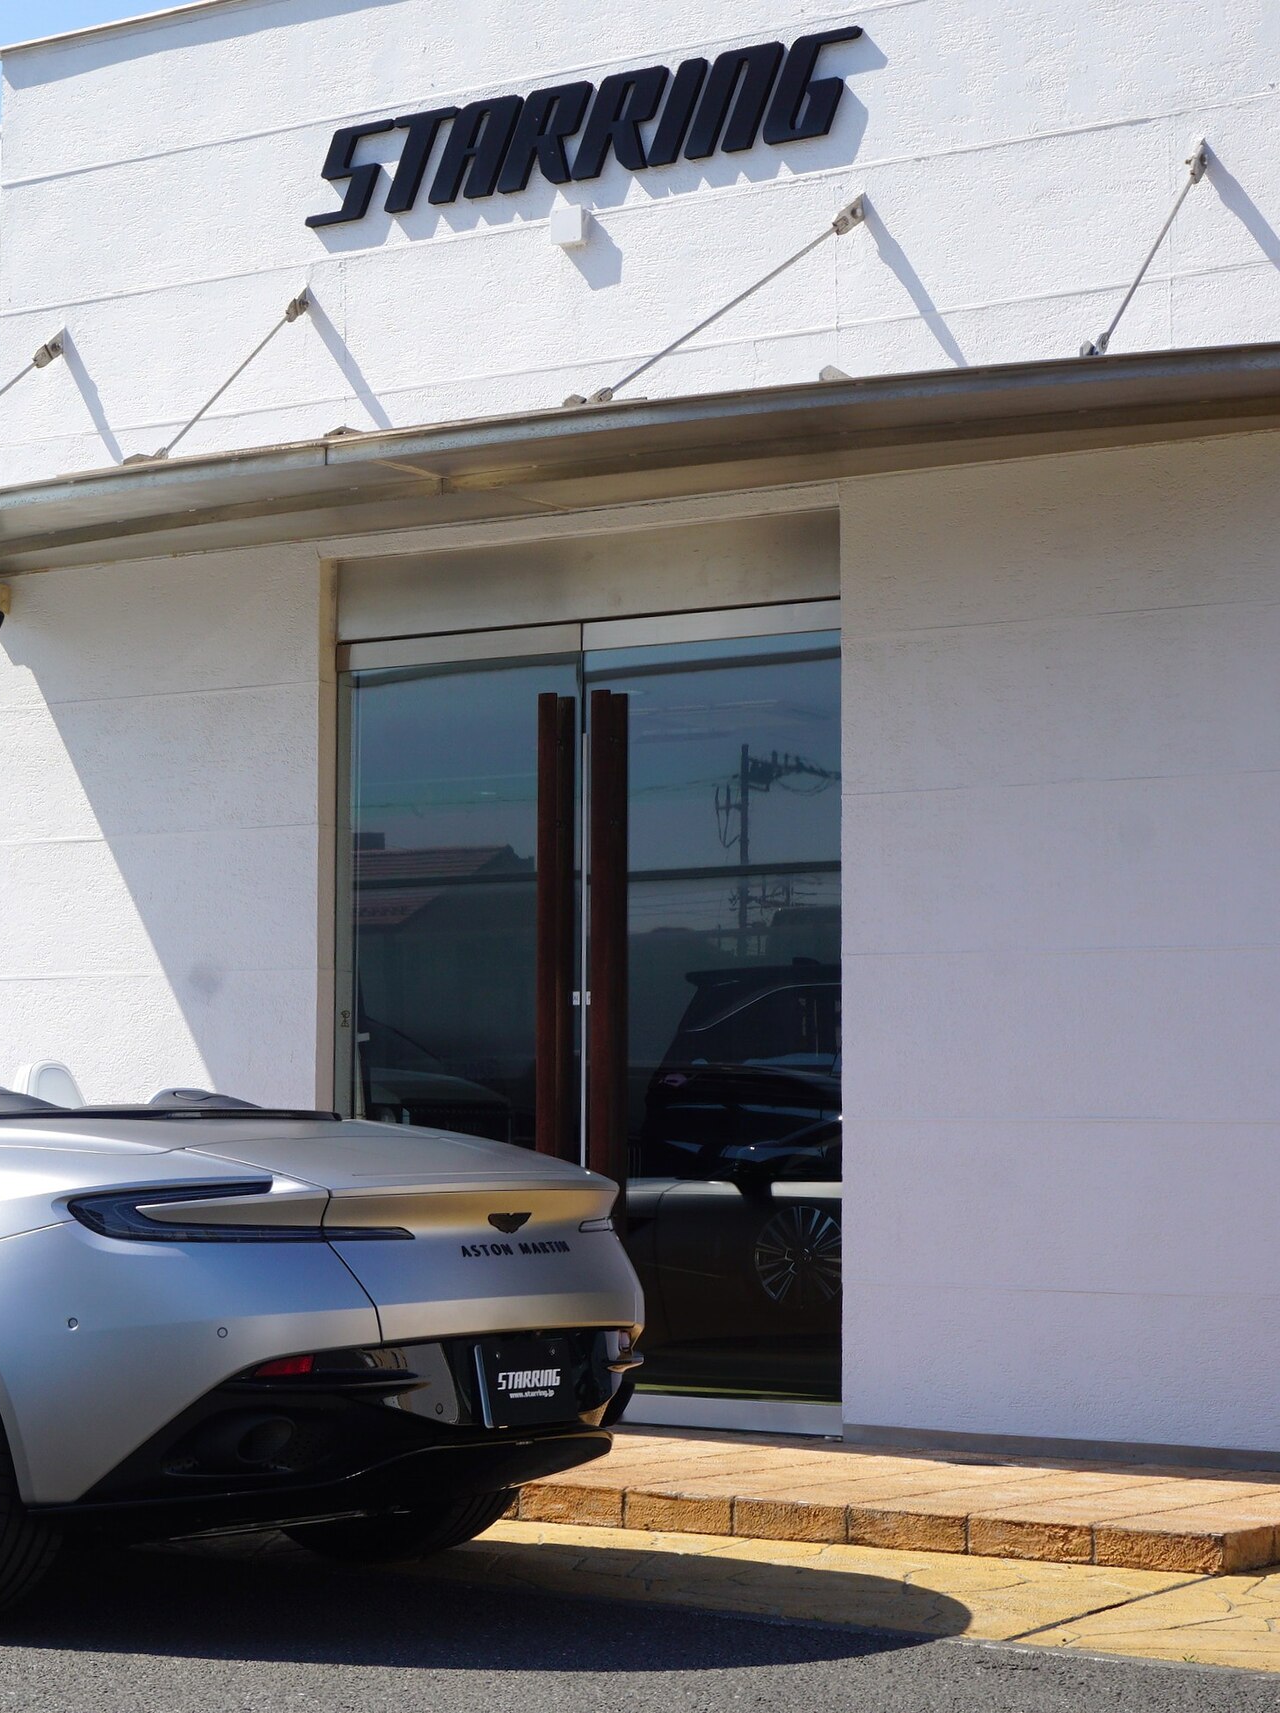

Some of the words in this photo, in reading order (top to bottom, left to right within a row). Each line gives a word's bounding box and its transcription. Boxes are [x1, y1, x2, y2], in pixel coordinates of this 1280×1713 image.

[305, 25, 863, 229] STARRING
[461, 1244, 514, 1257] ASTON
[518, 1241, 570, 1255] MARTIN
[497, 1368, 561, 1390] STARRING
[509, 1389, 555, 1398] www.starring.jp
